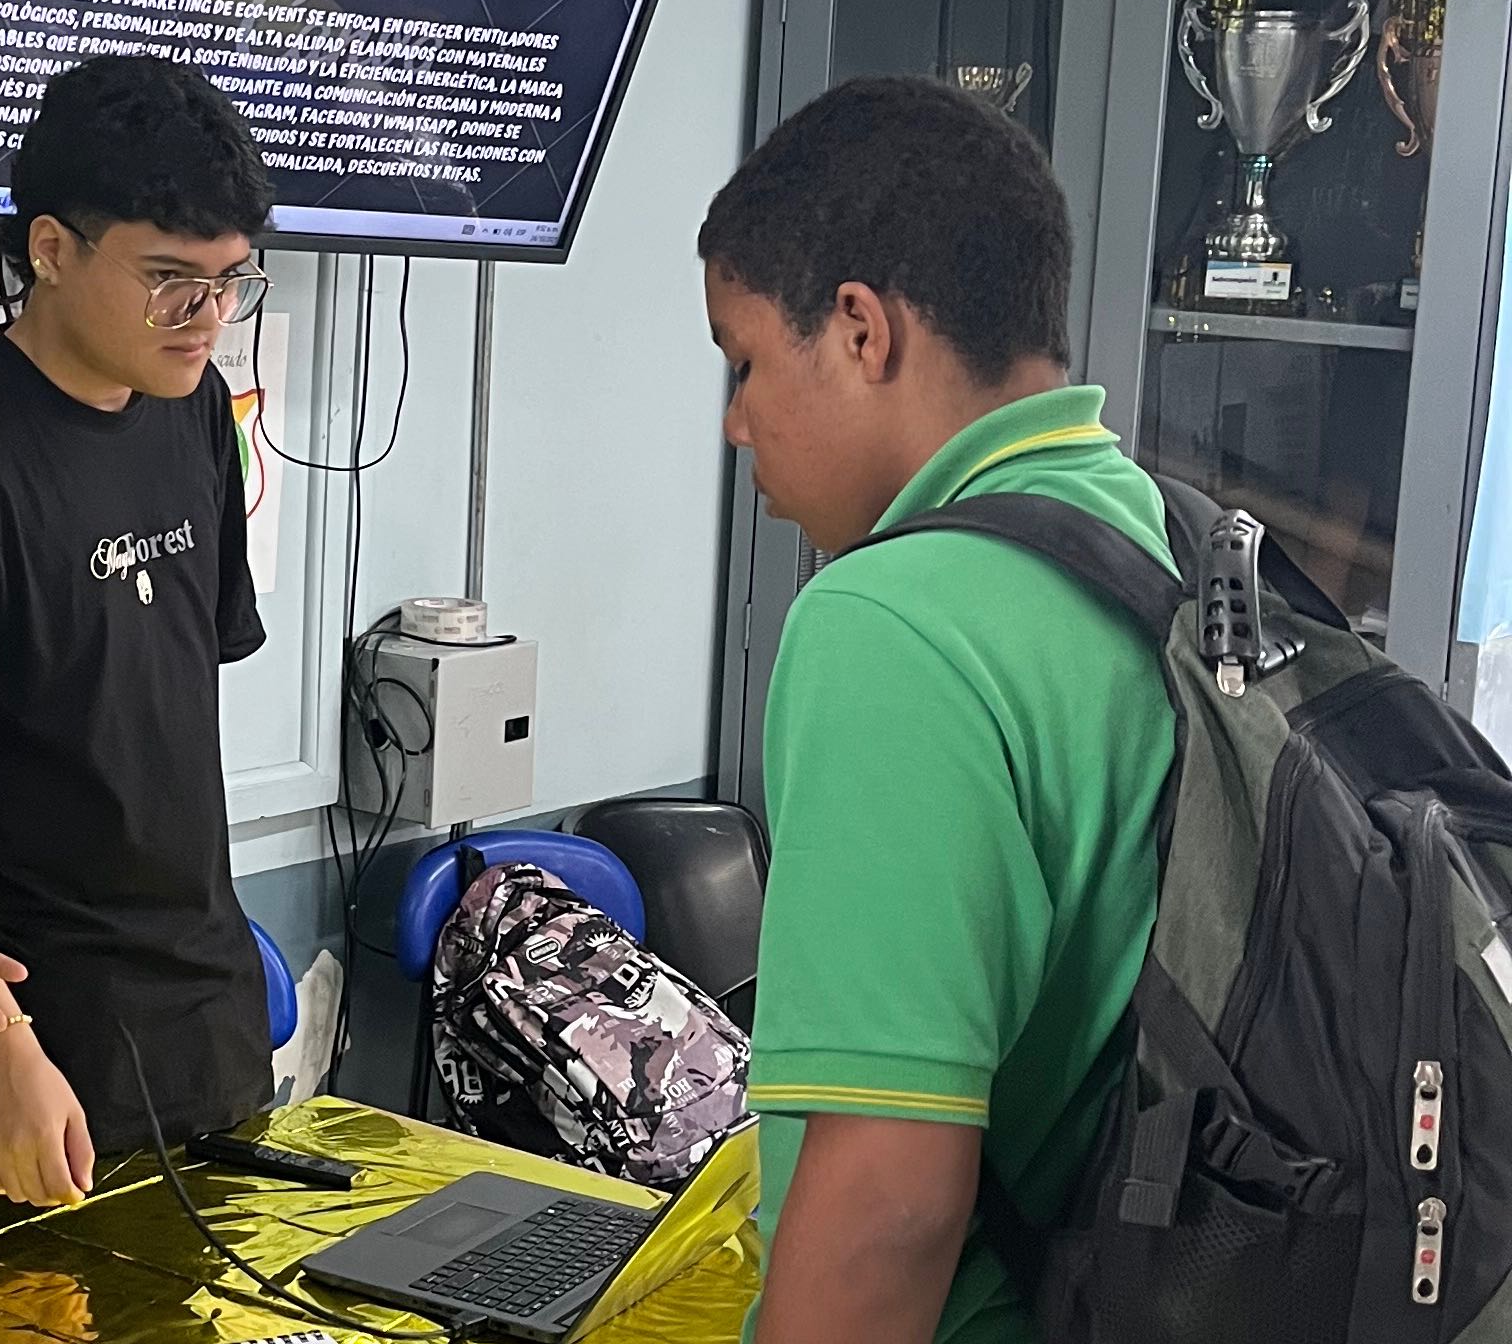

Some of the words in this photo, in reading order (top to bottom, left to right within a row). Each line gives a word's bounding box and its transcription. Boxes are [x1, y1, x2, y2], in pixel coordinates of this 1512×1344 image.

[82, 11, 214, 39] PERSONALIZADOS
[225, 26, 246, 43] DE
[245, 28, 283, 48] ALTA
[284, 33, 347, 56] CALIDAD,
[349, 39, 437, 62] ELABORADOS
[437, 47, 465, 64] CON
[466, 50, 546, 72] MATERIALES
[213, 0, 234, 16] DE
[235, 2, 307, 23] ECO-VENT
[306, 8, 325, 26] SE
[326, 11, 380, 33] ENFOCA
[382, 17, 404, 35] EN
[403, 20, 464, 41] OFRECER
[464, 26, 560, 50] VENTILADORES
[46, 34, 77, 53] QUE
[172, 48, 191, 65] LA
[193, 48, 308, 74] SOSTENIBILIDAD
[319, 62, 337, 79] LA
[339, 62, 413, 85] EFICIENCIA
[415, 69, 498, 93] ENERGÉTICA.
[500, 78, 517, 94] LA
[518, 80, 563, 99] MARCA
[25, 82, 47, 100] DE
[300, 107, 374, 129] FACEBOOK
[383, 115, 458, 138] WHATSAPP,
[460, 121, 506, 139] DONDE
[506, 124, 523, 140] SE
[209, 75, 283, 96] MEDIANTE
[283, 83, 312, 101] UNA
[314, 86, 417, 108] COMUNICACIÓN
[417, 94, 477, 115] CERCANA
[489, 101, 550, 121] MODERNA
[550, 106, 562, 122] A
[308, 132, 326, 149] SE
[328, 133, 413, 154] FORTALECEN
[413, 138, 440, 156] LAS
[440, 142, 517, 162] RELACIONES
[517, 148, 547, 164] CON
[348, 159, 432, 180] DESCUENTOS
[442, 166, 482, 182] RIFAS.
